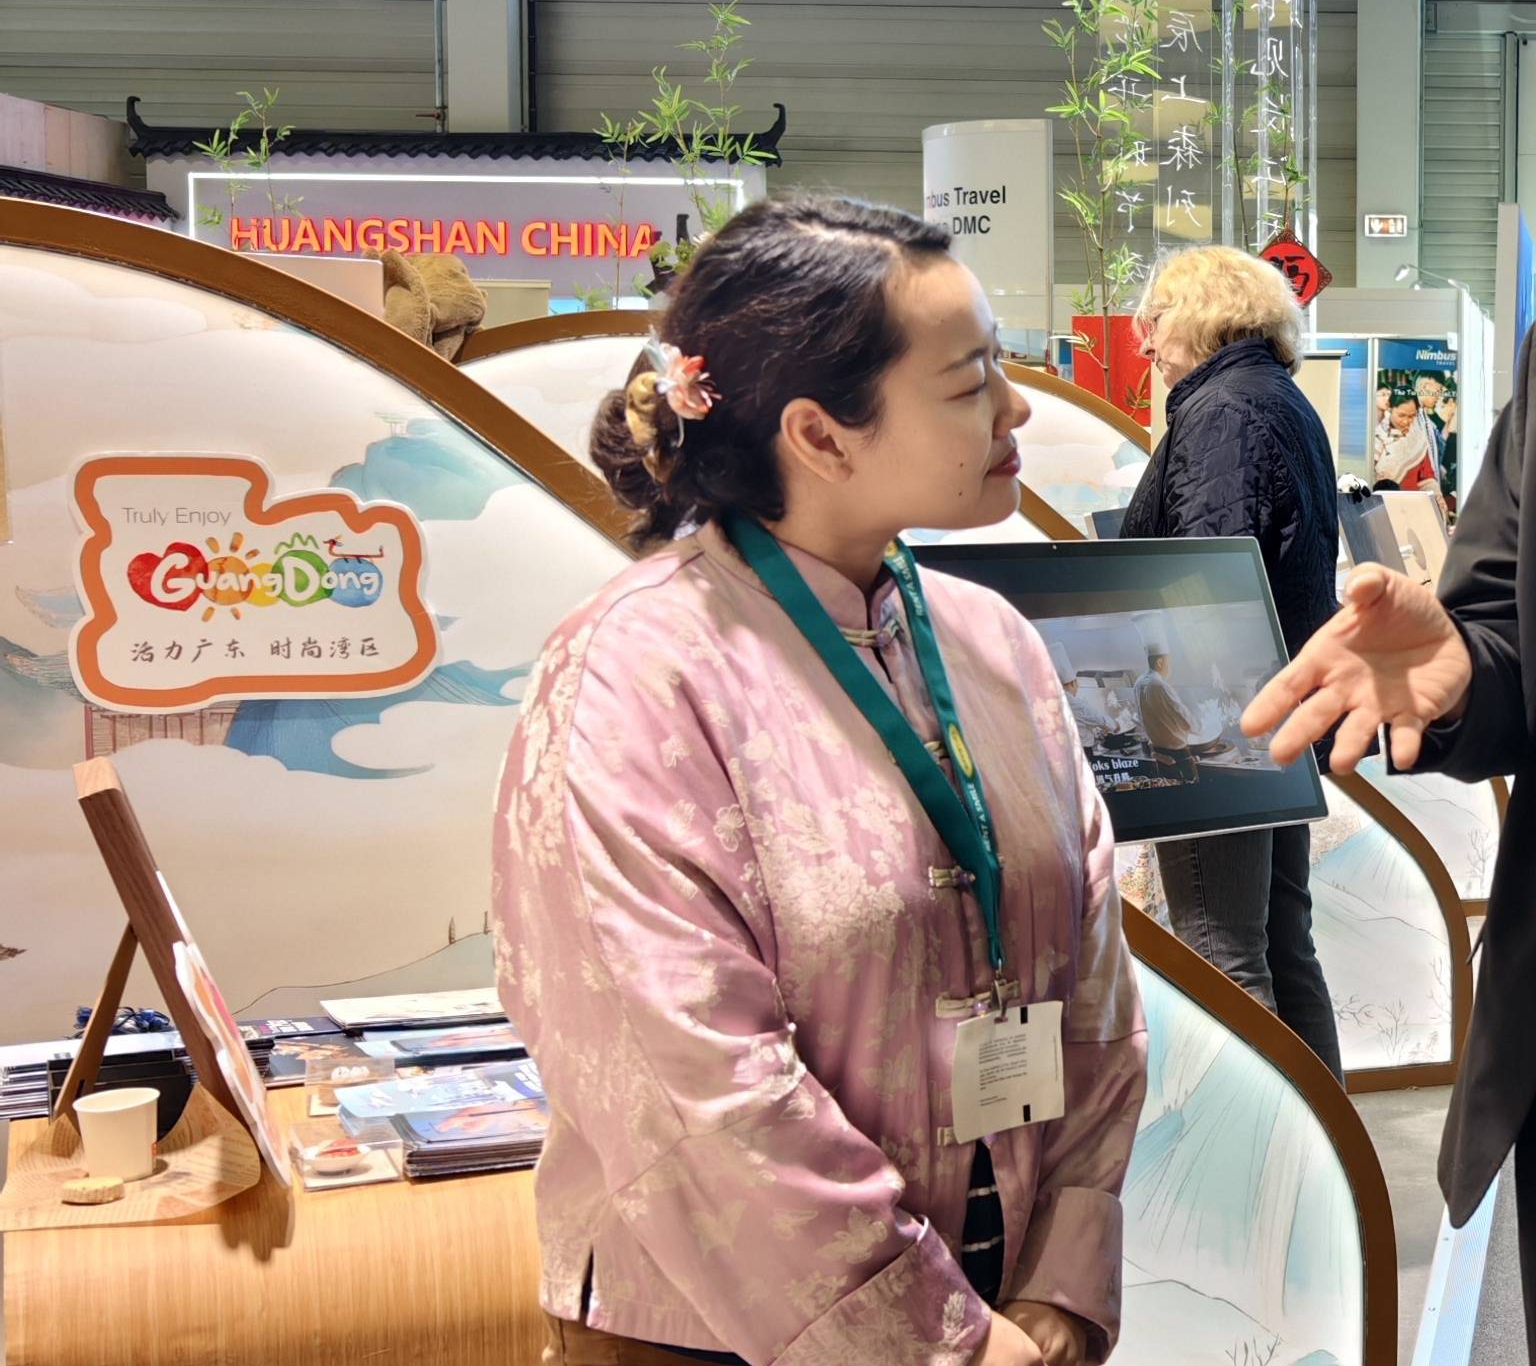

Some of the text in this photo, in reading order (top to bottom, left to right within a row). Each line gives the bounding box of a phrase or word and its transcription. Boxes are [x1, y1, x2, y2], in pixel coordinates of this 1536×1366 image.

[953, 185, 1007, 206] Travel
[952, 215, 991, 235] DMC
[230, 217, 660, 258] HUANGSHAN CHINA
[1415, 347, 1457, 361] Nimbus
[122, 507, 232, 526] Truly Enjoy
[150, 552, 380, 603] GuangDong
[130, 636, 381, 664] 活力广东 时尚湾区
[1111, 758, 1140, 770] blaze
